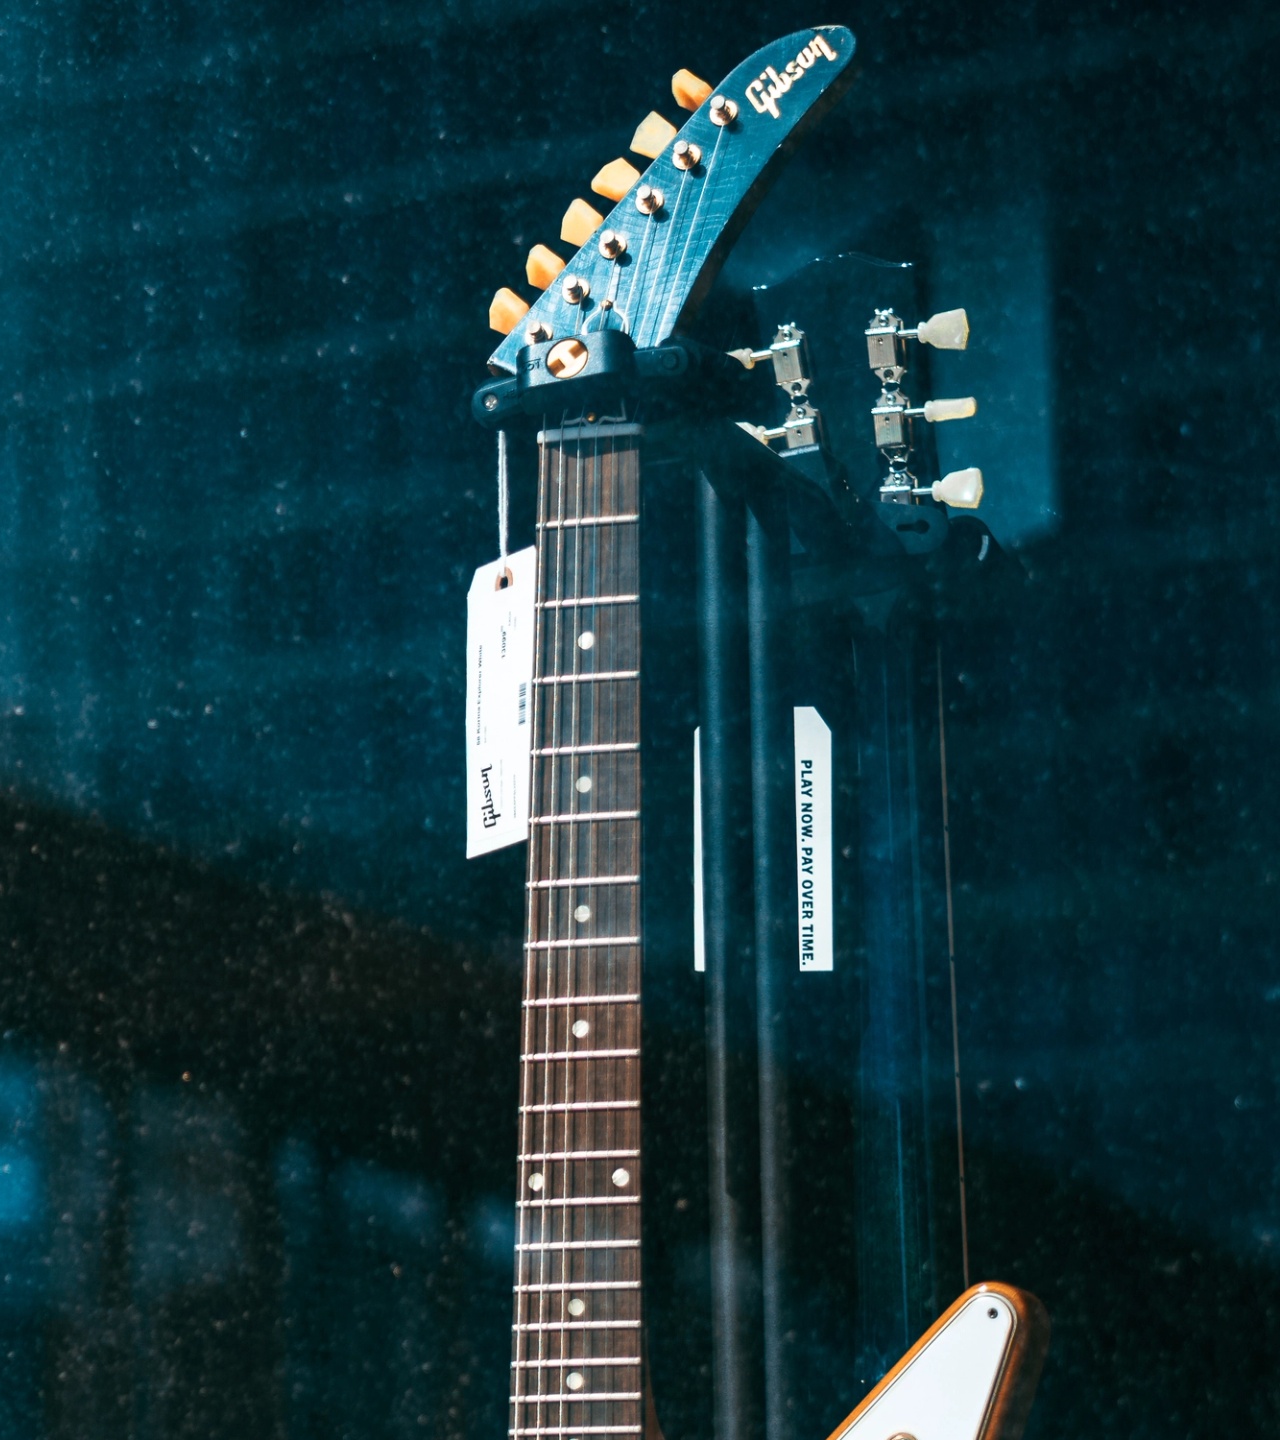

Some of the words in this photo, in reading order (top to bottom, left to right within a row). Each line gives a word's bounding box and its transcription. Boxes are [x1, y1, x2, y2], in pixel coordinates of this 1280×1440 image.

[744, 33, 838, 119] Gibson
[480, 763, 501, 829] Gibson
[800, 759, 813, 797] PLAY
[800, 802, 813, 842] NOW.
[801, 847, 814, 875] PAY
[801, 880, 814, 919] OVER
[801, 924, 815, 966] TIME.
